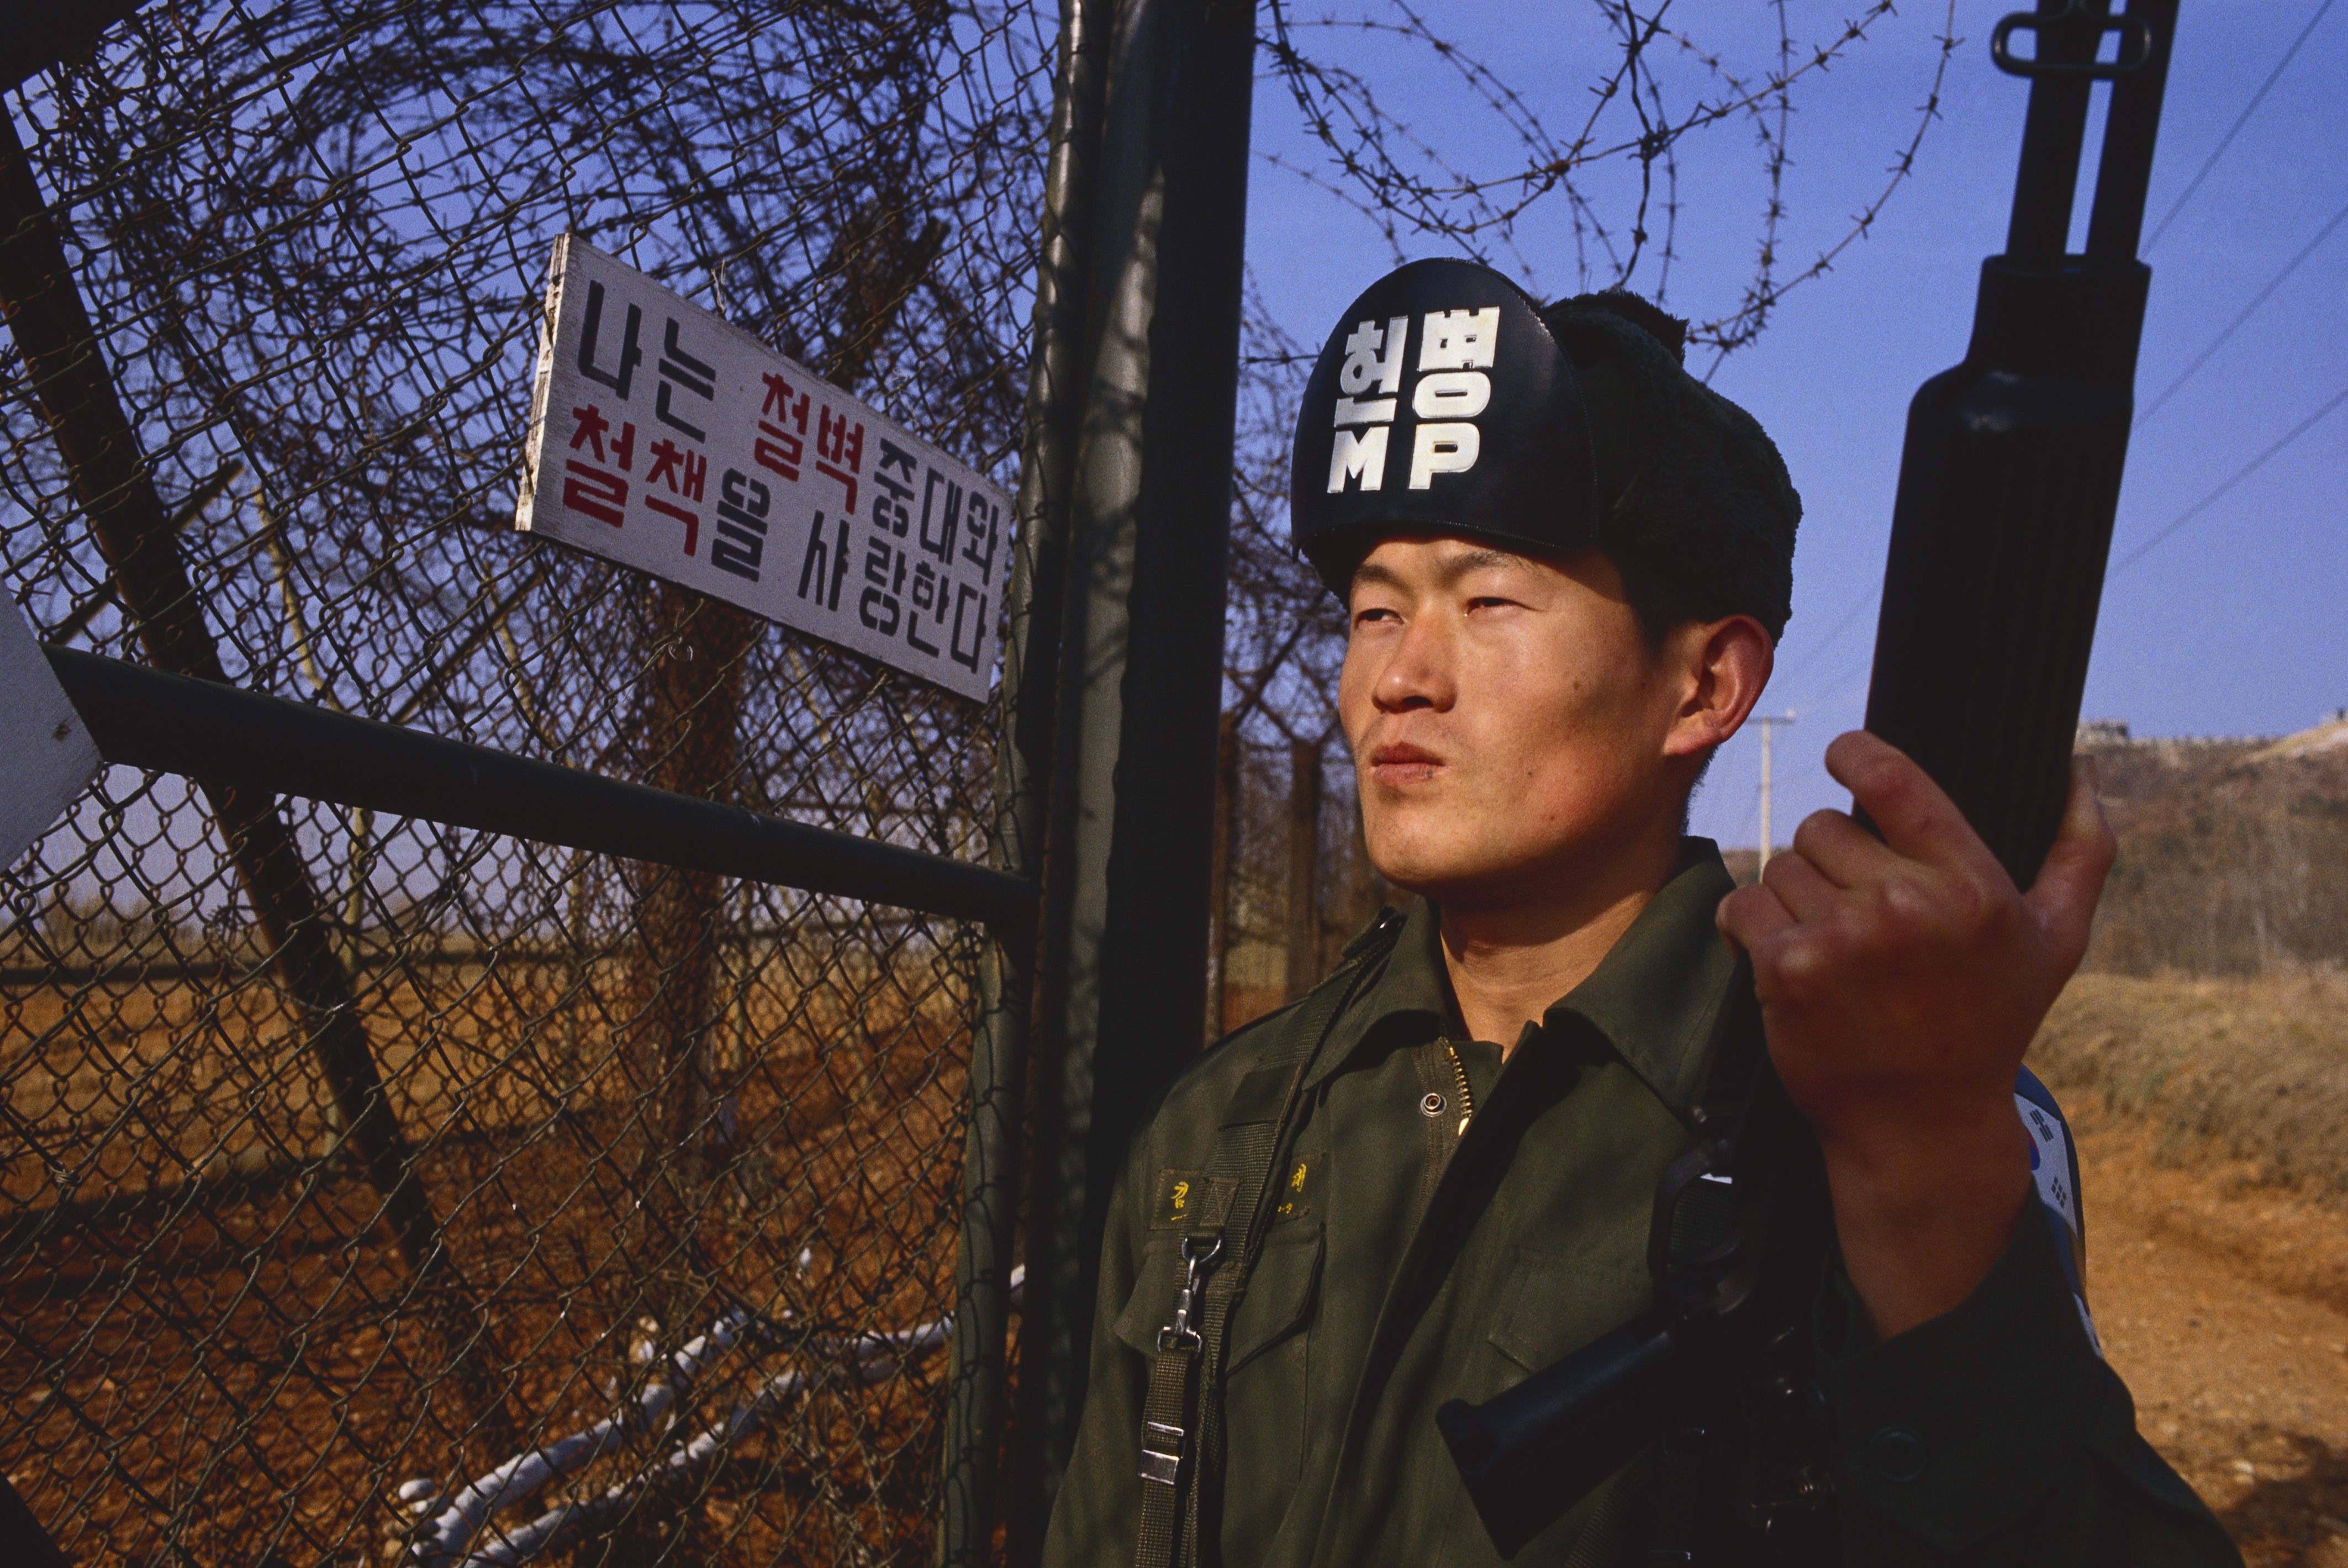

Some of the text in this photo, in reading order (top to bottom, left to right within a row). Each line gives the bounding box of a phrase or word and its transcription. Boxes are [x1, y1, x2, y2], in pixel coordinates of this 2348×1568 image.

[578, 280, 716, 443] 나는
[1333, 306, 1500, 427] 헌병
[1327, 423, 1480, 493] MP
[562, 403, 987, 674] 철책을 사랑한다
